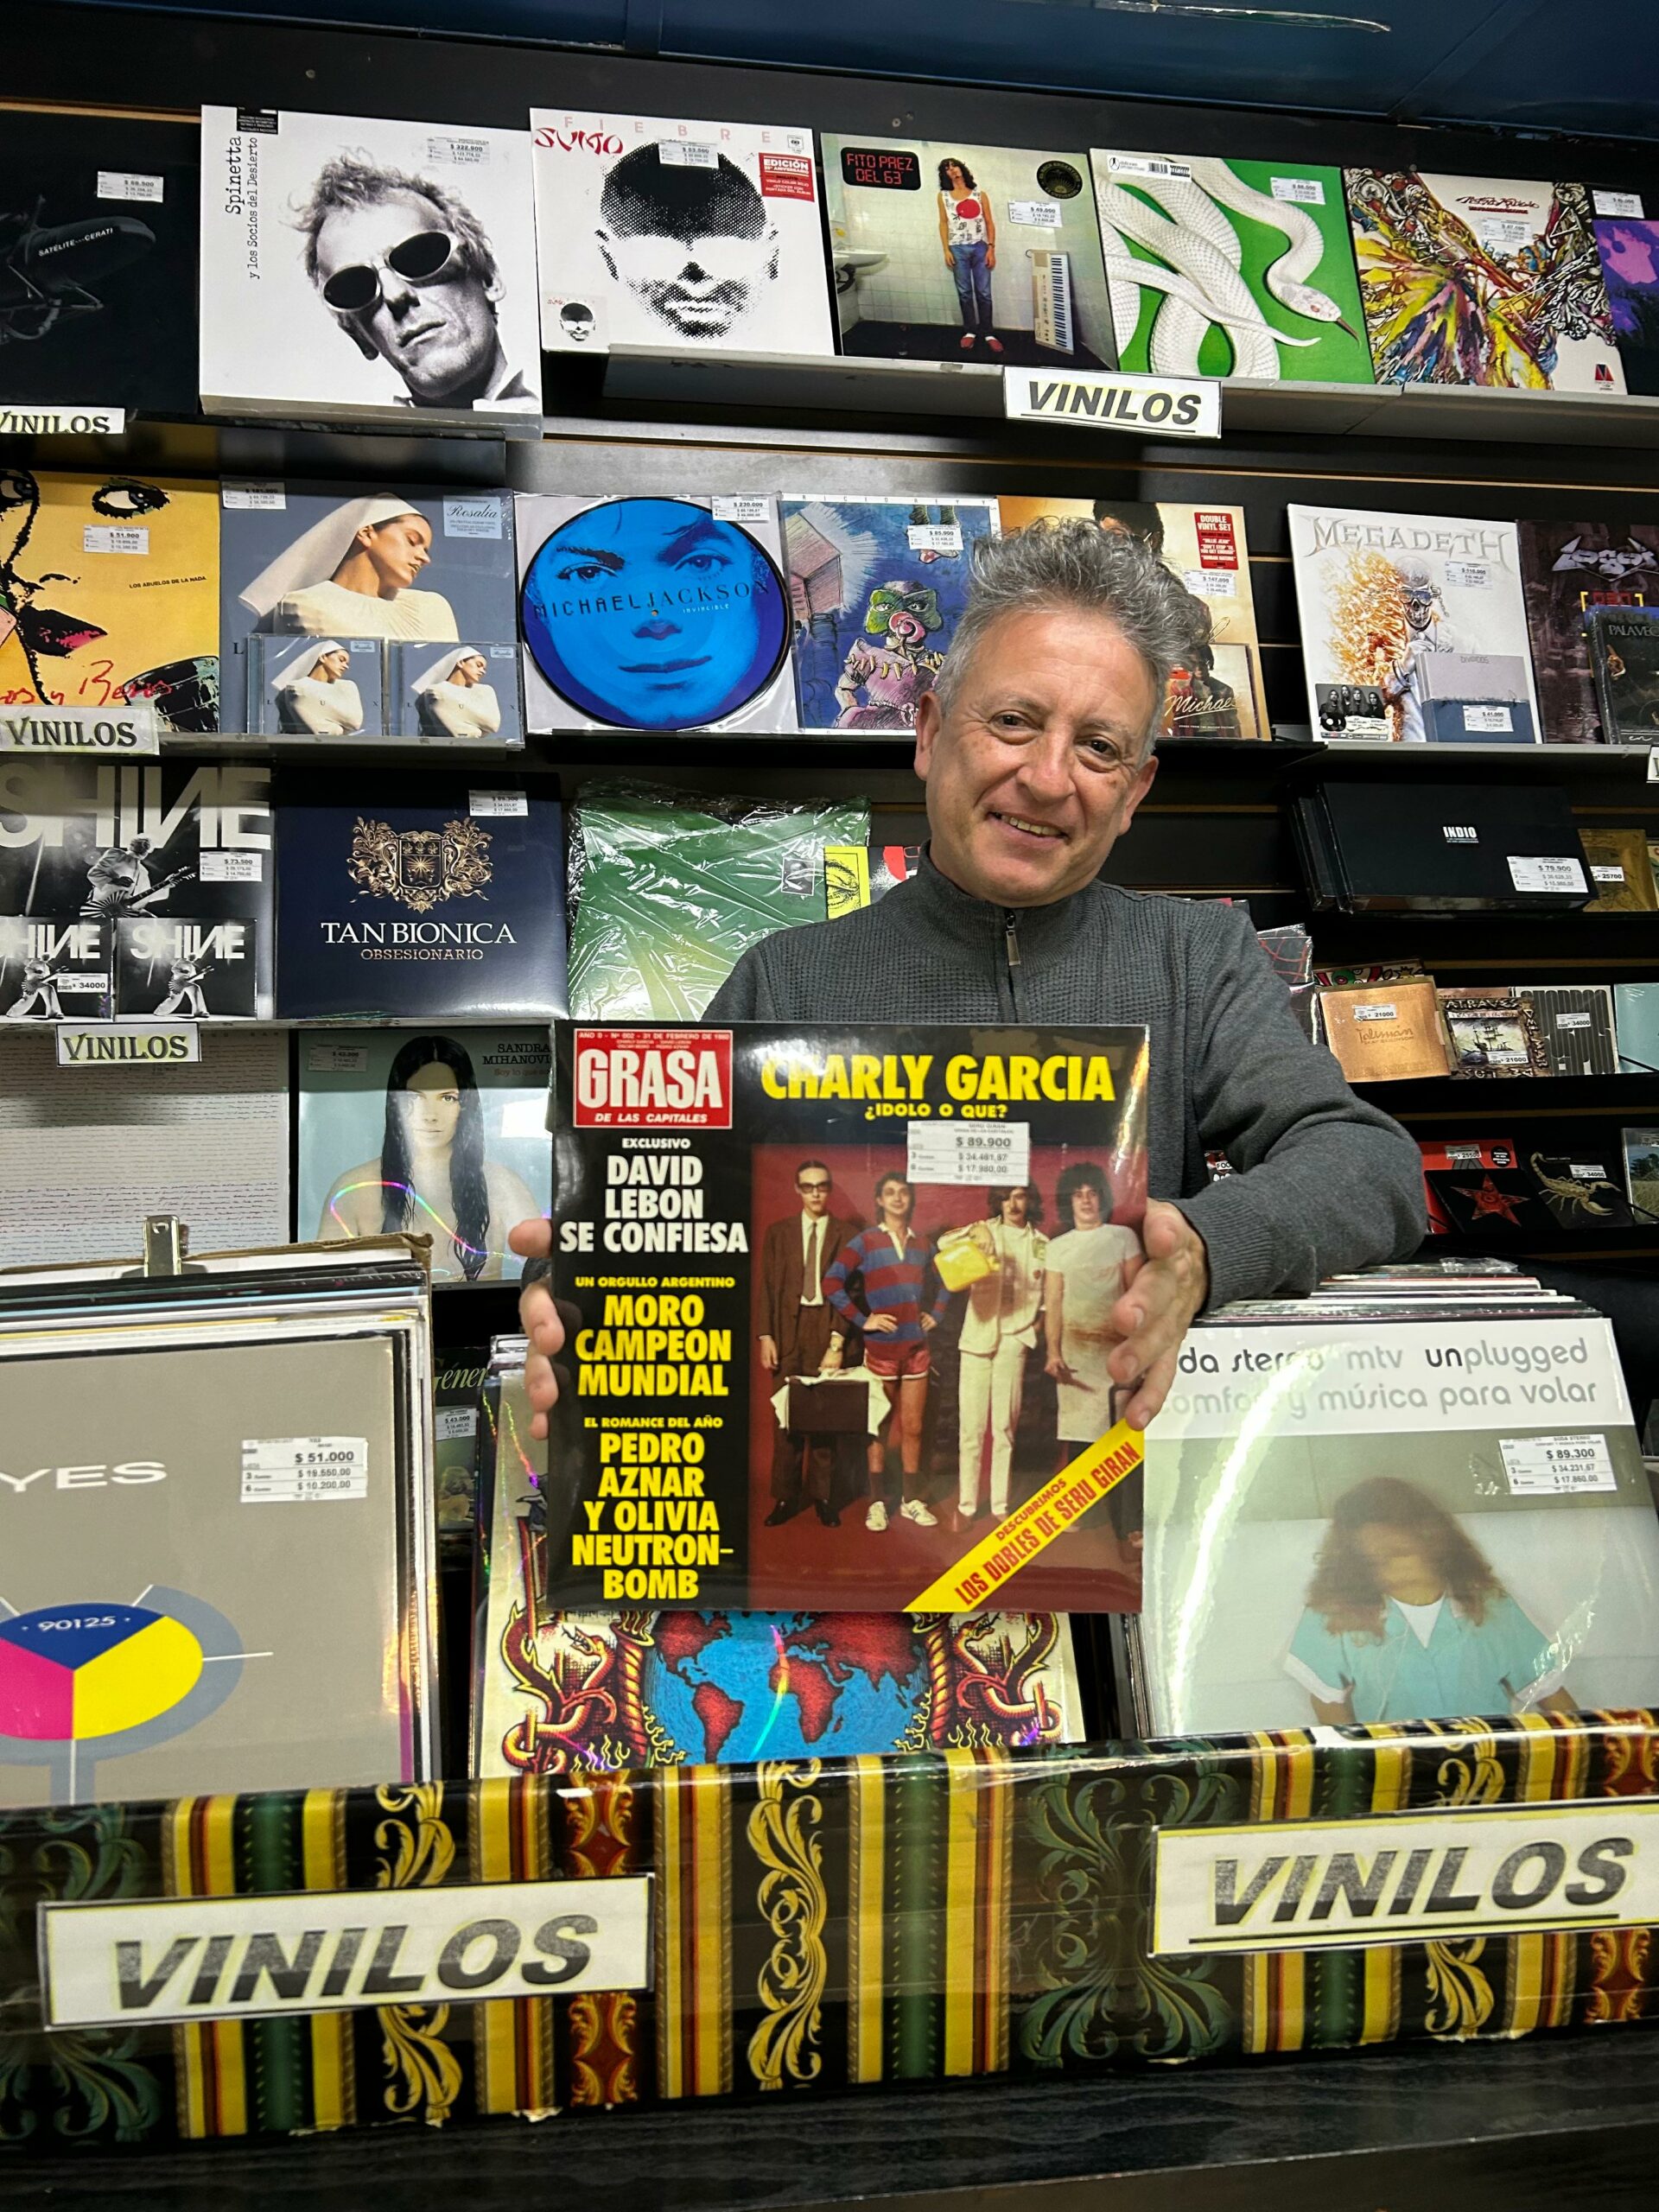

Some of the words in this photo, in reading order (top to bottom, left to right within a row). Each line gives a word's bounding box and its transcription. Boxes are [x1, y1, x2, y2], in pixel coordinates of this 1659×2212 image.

[564, 117, 771, 143] FIEBRE
[226, 136, 245, 214] Spinetta
[247, 137, 258, 187] Desierto
[764, 158, 809, 170] EDICIÓN
[846, 153, 876, 168] FITO
[879, 156, 913, 171] PAEZ
[855, 168, 881, 183] DEL
[883, 170, 902, 185] 63
[247, 188, 258, 208] del
[84, 227, 113, 241] CERATI
[247, 215, 258, 247] Socios
[247, 251, 258, 269] los
[1029, 381, 1202, 425] VINILOS
[1197, 522, 1218, 531] VINYL
[1218, 523, 1231, 531] SET
[1199, 514, 1227, 523] DOUBLE
[1297, 515, 1516, 574] MEGADETH
[534, 594, 640, 620] MICHAEL
[646, 580, 770, 608] JACKSON
[683, 603, 729, 613] INVINCIBLE
[5, 715, 137, 747] VINILOS
[1442, 826, 1478, 838] INDIO
[321, 922, 386, 944] TAN
[391, 922, 518, 944] BIONICA
[360, 949, 484, 961] OBSESIONARIO
[63, 1032, 189, 1061] VINILOS
[482, 1054, 552, 1065] MIHANOVI
[497, 1043, 550, 1052] SANDRA
[578, 1048, 723, 1109] GRASA
[760, 1054, 933, 1101] CHARLY
[945, 1055, 1116, 1102] GARCIA
[594, 1112, 612, 1122] DE
[618, 1113, 640, 1122] LAS
[645, 1113, 708, 1123] CAPITALES
[865, 1103, 931, 1121] ¿IDOLO
[938, 1103, 954, 1119] O
[960, 1103, 1007, 1119] QUE?
[622, 1136, 691, 1150] EXCLUSIVO
[956, 1136, 963, 1147] $
[967, 1137, 1012, 1147] 89.900
[607, 1154, 703, 1185] DAVID
[605, 1188, 703, 1219] LEBON
[559, 1221, 594, 1253] SE
[603, 1221, 749, 1254] CONFIESA
[575, 1276, 595, 1288] UN
[598, 1276, 658, 1288] ORGULLO
[661, 1276, 735, 1288] ARGENTINO
[603, 1294, 705, 1327] MORO
[575, 1329, 732, 1362] CAMPEON
[1179, 1346, 1219, 1374] da
[1348, 1345, 1403, 1370] mtv
[1426, 1338, 1589, 1374] unplugged
[577, 1363, 728, 1396] MUNDIAL
[1287, 1390, 1306, 1420] y
[1318, 1383, 1428, 1410] música
[1440, 1387, 1510, 1414] para
[1522, 1377, 1596, 1405] volar
[584, 1416, 597, 1428] EL
[601, 1416, 664, 1428] ROMANCE
[668, 1416, 690, 1428] DEL
[694, 1414, 723, 1428] AÑO
[295, 1453, 303, 1463] $
[308, 1451, 354, 1462] 51.000
[600, 1432, 705, 1464] PEDRO
[1546, 1450, 1554, 1459] $
[1556, 1448, 1595, 1459] 89.300
[0, 1461, 168, 1493] YES
[297, 1470, 303, 1478] $
[297, 1482, 303, 1491] $
[307, 1480, 351, 1490] 10.200,00
[598, 1466, 705, 1498] AZNAR
[583, 1501, 606, 1531] Y
[613, 1501, 720, 1532] OLIVIA
[955, 1572, 989, 1605] LOS
[982, 1525, 1040, 1581] DOBLES
[1033, 1510, 1061, 1538] DE
[1054, 1479, 1097, 1521] SERU
[1090, 1441, 1141, 1489] GIRAN
[995, 1478, 1067, 1541] DESCUBRIMOS
[572, 1534, 734, 1566] NEUTRON-
[603, 1568, 699, 1599] BOMB
[37, 1615, 117, 1631] 90125
[1214, 1837, 1635, 1927] VINILOS
[115, 1914, 598, 2011] VINILOS
